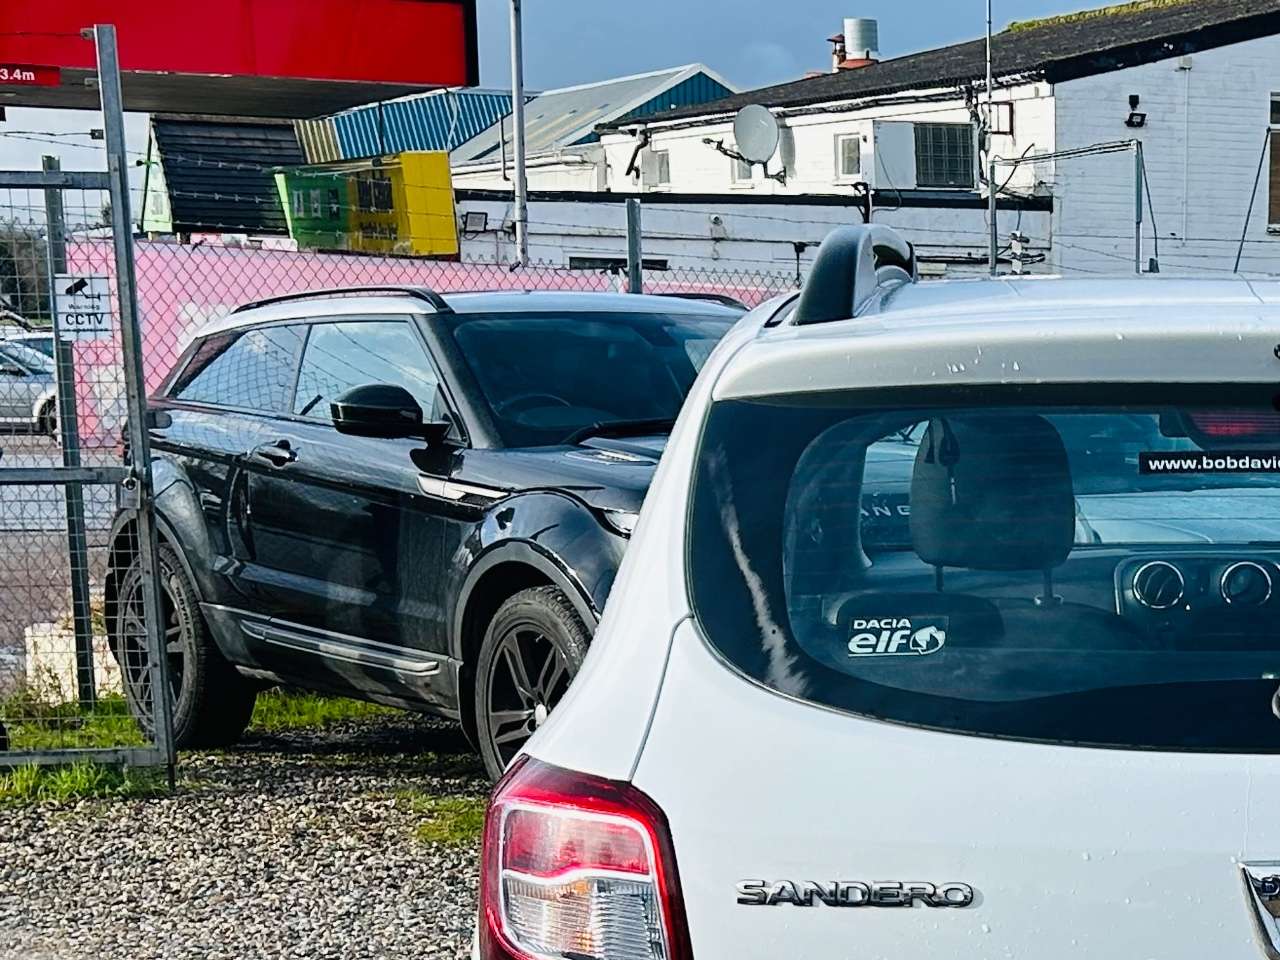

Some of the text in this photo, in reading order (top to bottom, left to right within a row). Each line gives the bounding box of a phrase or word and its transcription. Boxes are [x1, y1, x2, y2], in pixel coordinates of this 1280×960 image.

[0, 68, 35, 81] 3.4m
[66, 313, 104, 326] CCTV
[853, 618, 912, 630] DACIA
[848, 630, 912, 653] elf
[735, 879, 974, 908] SANDERO
